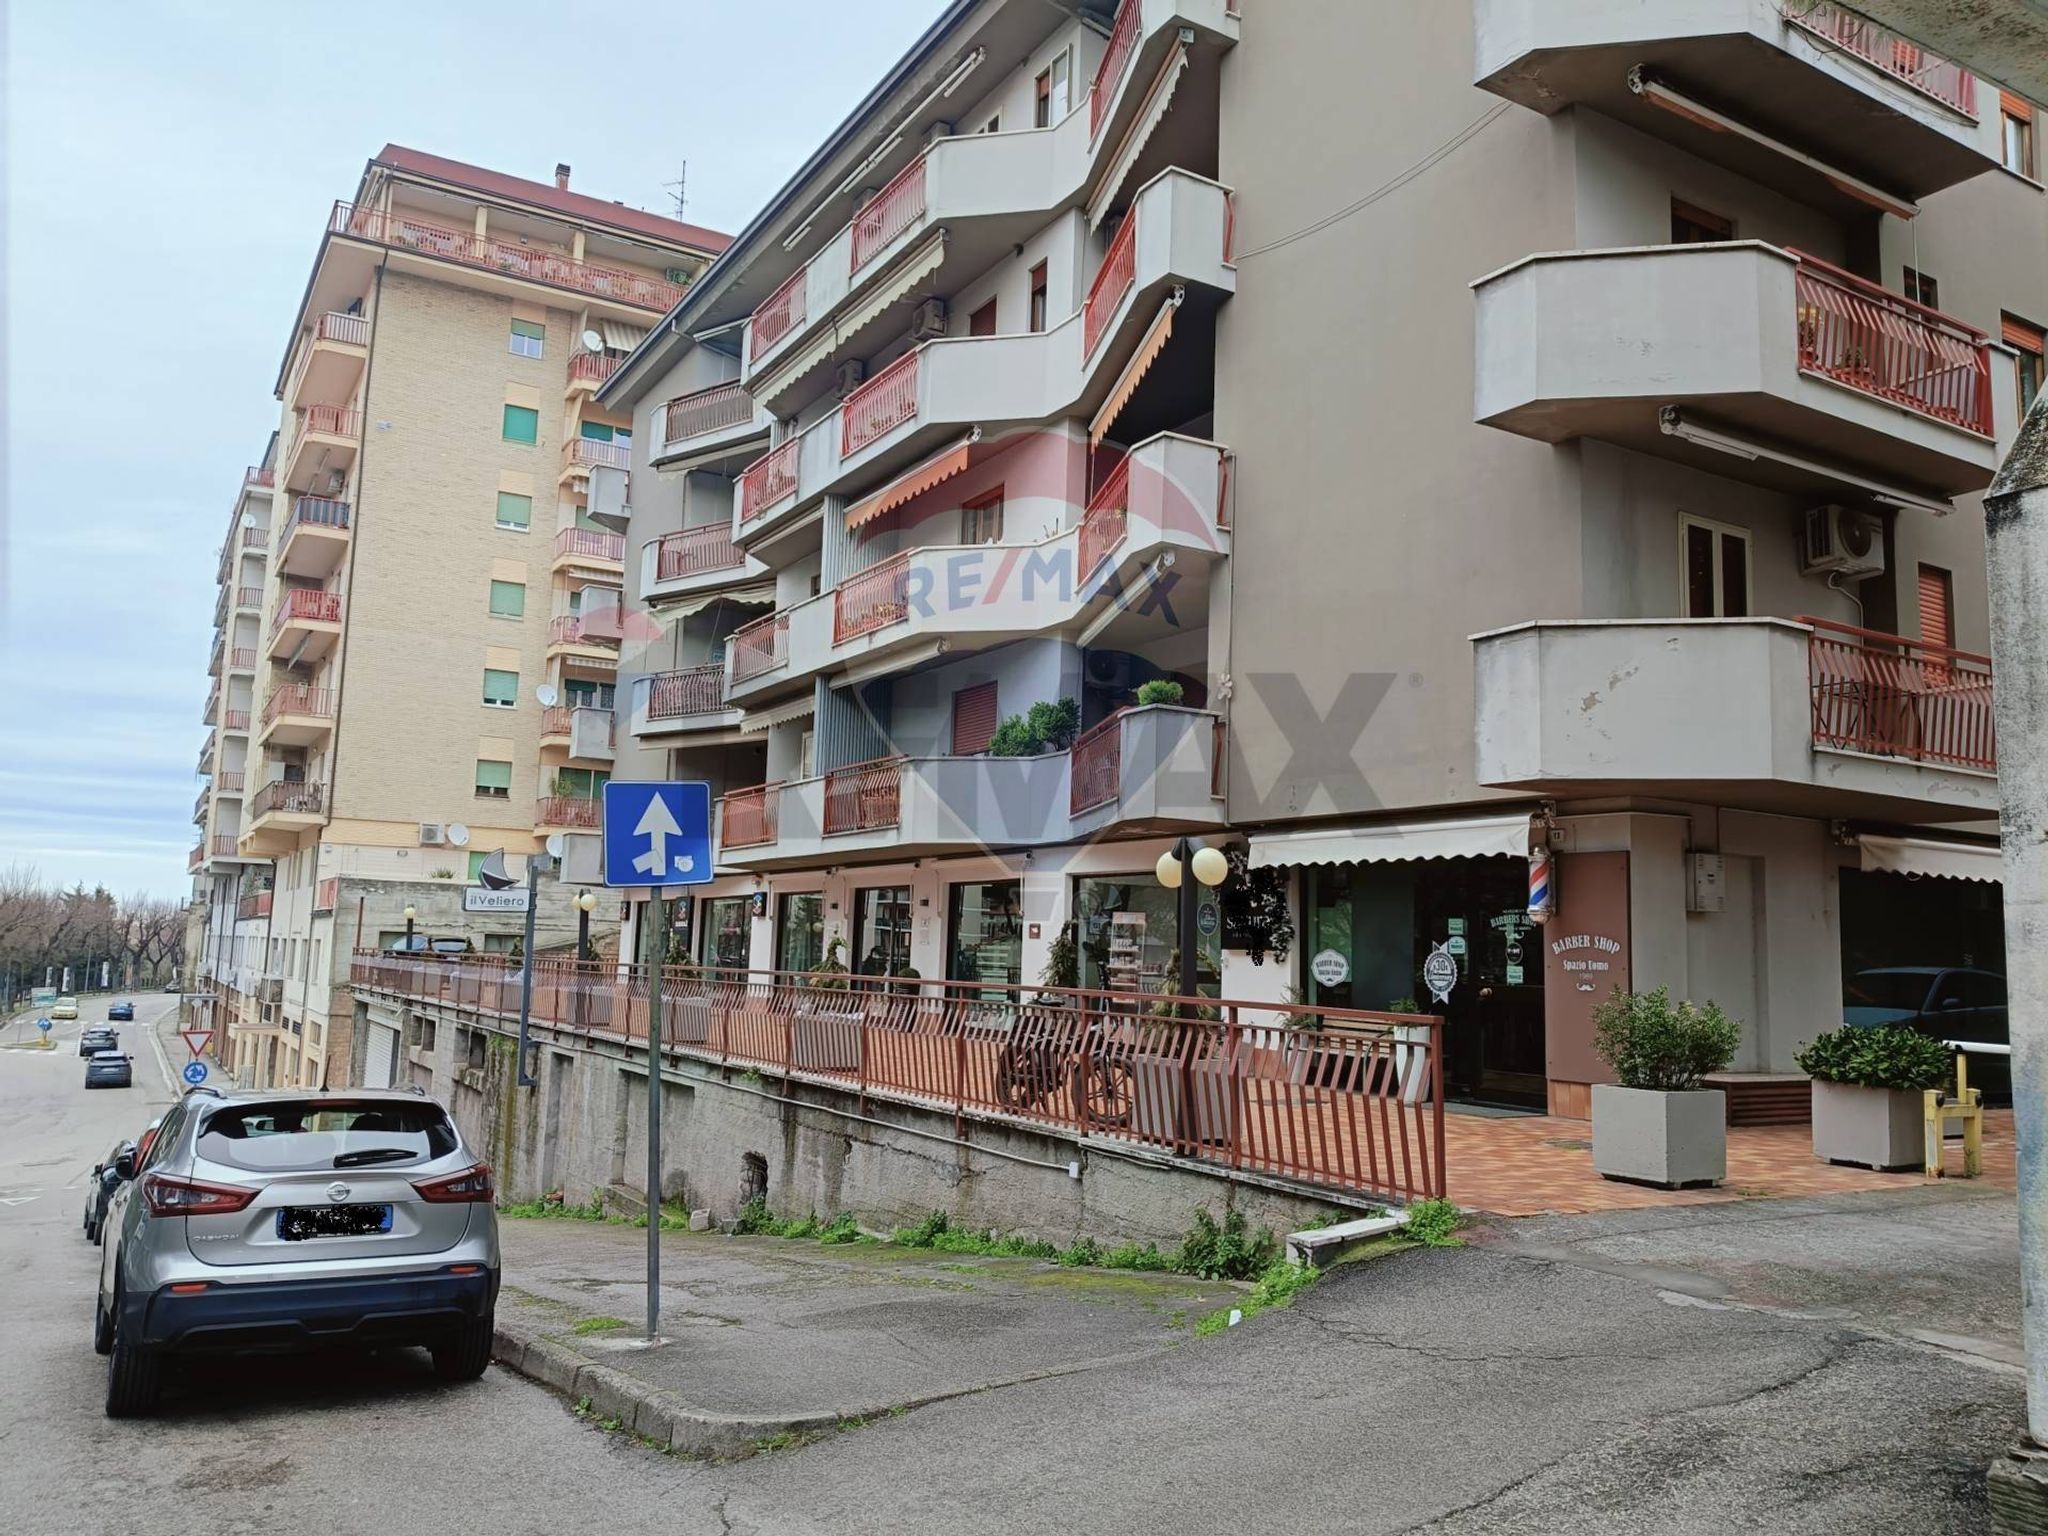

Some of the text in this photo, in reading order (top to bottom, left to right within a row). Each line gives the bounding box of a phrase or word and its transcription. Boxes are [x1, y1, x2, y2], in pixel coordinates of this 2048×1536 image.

[1552, 934, 1620, 955] BARBER SHOP
[1563, 960, 1586, 971] Spazio
